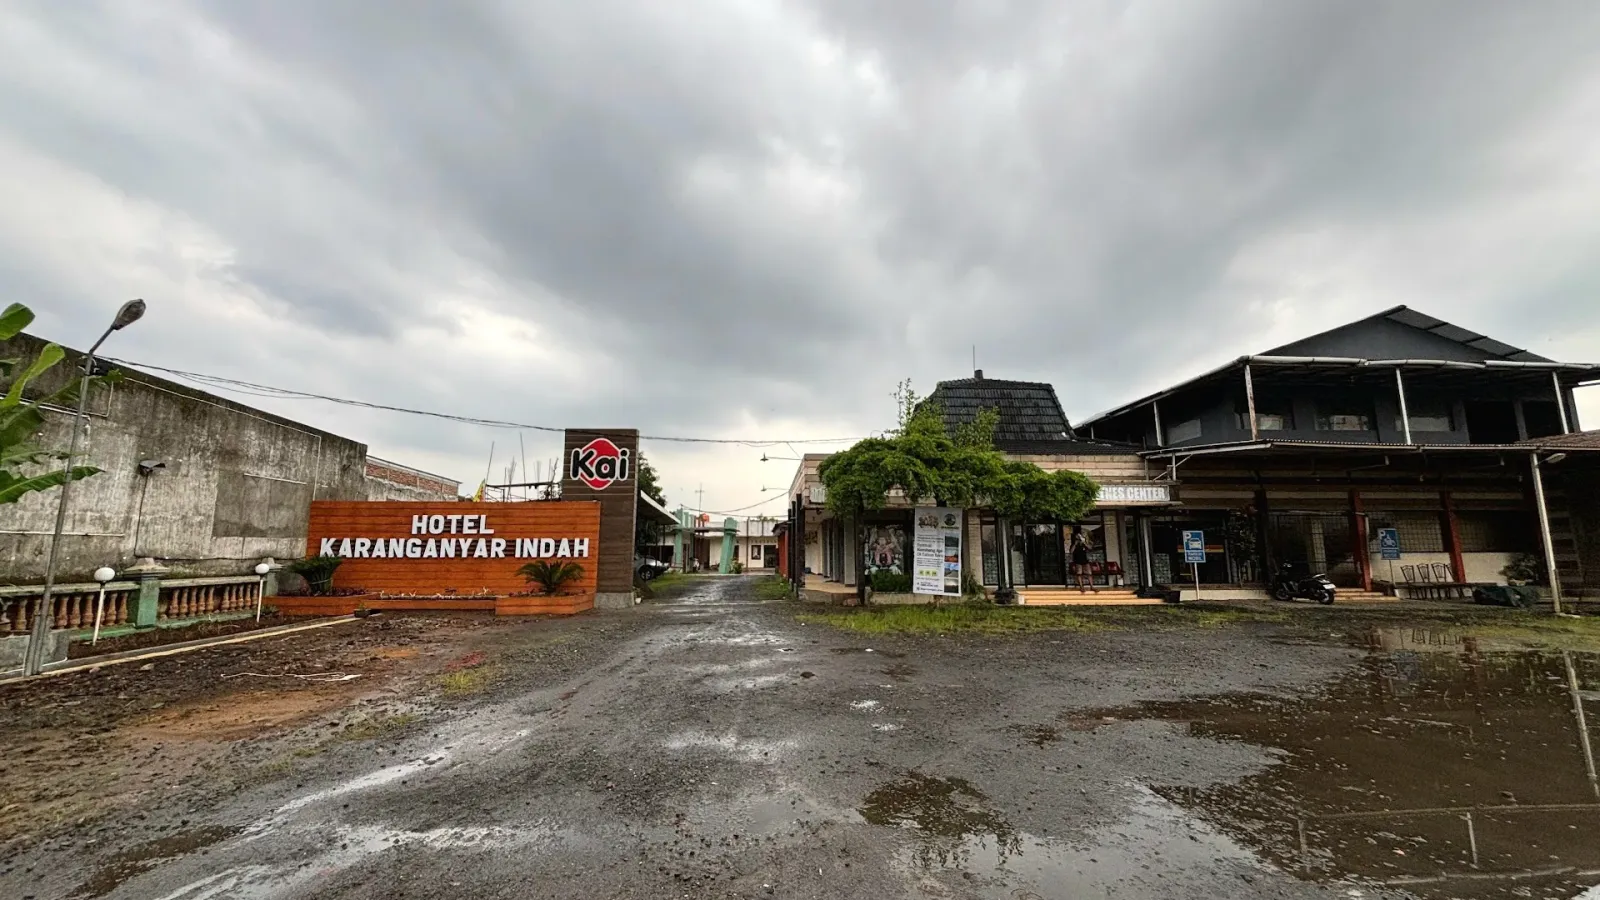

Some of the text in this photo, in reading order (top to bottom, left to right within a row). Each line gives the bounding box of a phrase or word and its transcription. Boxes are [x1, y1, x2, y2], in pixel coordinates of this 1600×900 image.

[570, 448, 629, 481] Kai
[1098, 487, 1165, 501] TNES CENTER
[411, 514, 494, 534] HOTEL
[1184, 532, 1192, 542] P
[1379, 530, 1386, 540] P
[319, 537, 589, 558] KARANGANYAR INDAH
